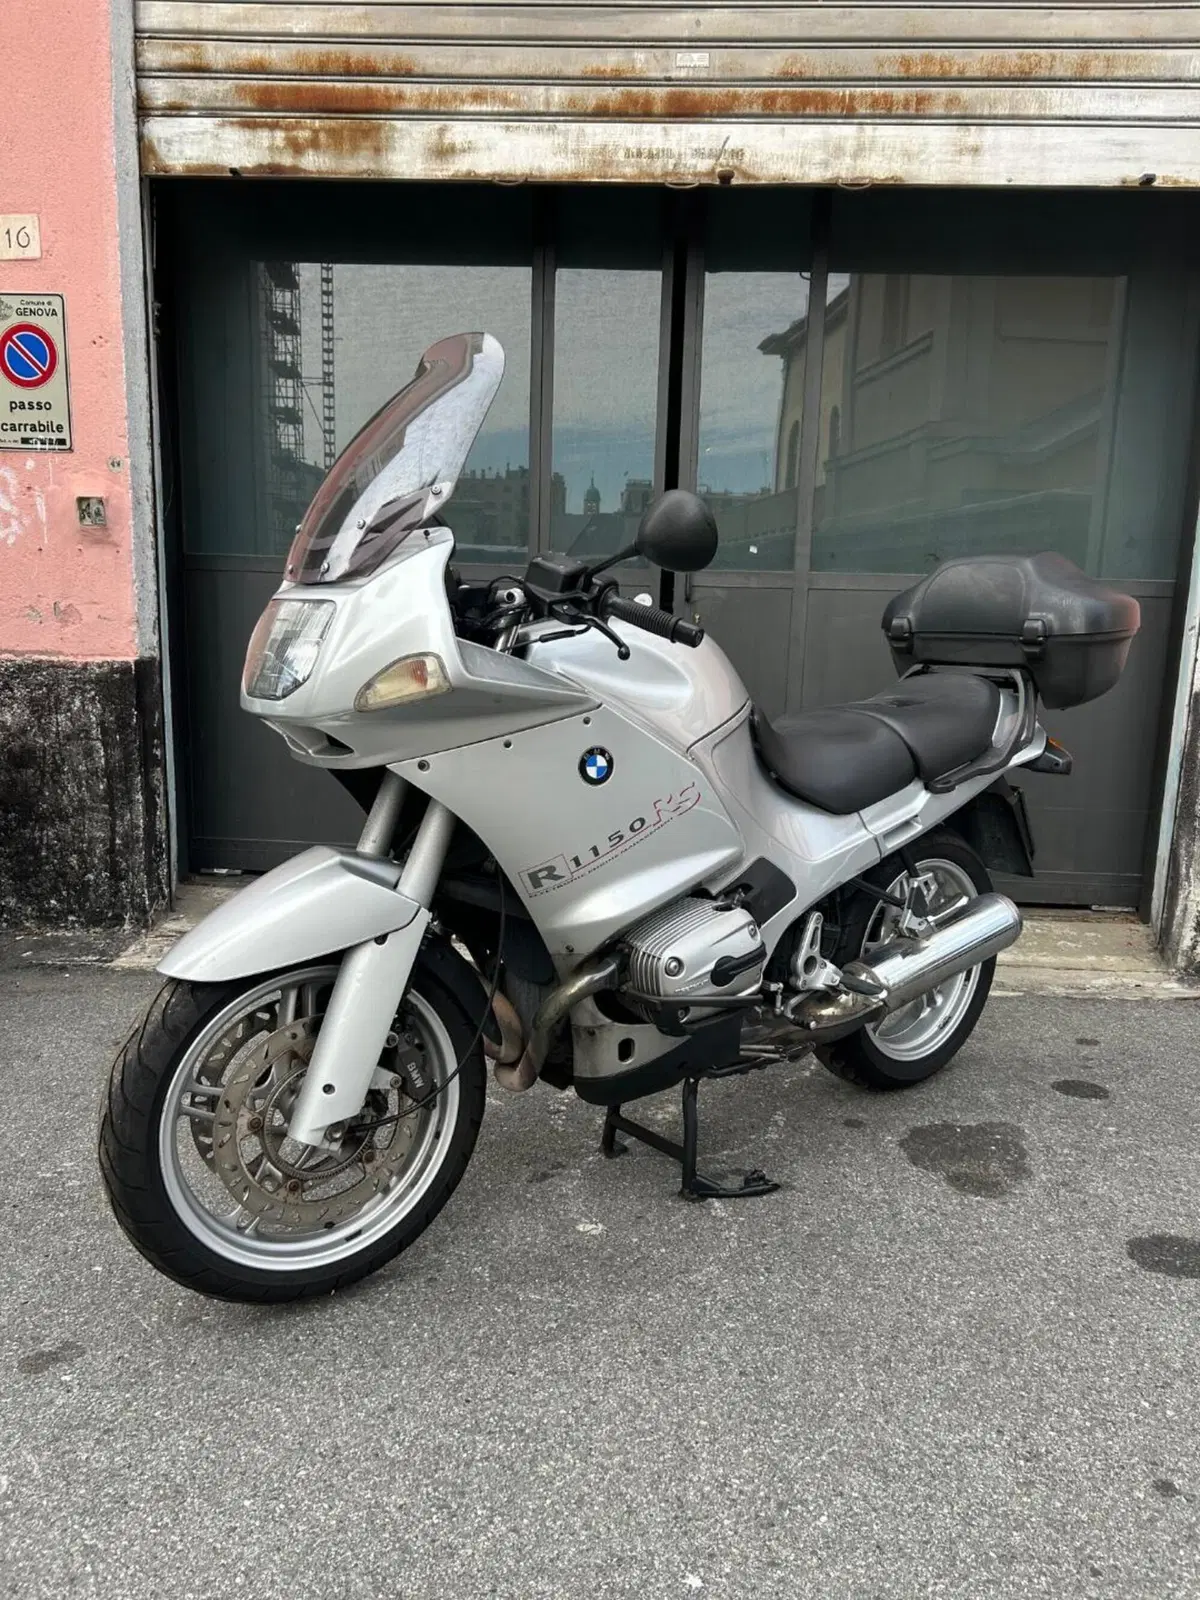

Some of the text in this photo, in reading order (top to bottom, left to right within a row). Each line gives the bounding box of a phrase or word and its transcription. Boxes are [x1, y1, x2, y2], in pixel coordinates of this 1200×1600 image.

[5, 226, 30, 249] 16
[15, 307, 58, 317] GENOVA
[9, 400, 52, 413] passo
[0, 420, 64, 433] carrabile
[527, 865, 566, 890] R
[570, 817, 646, 868] 1150
[407, 1062, 425, 1088] BMW
